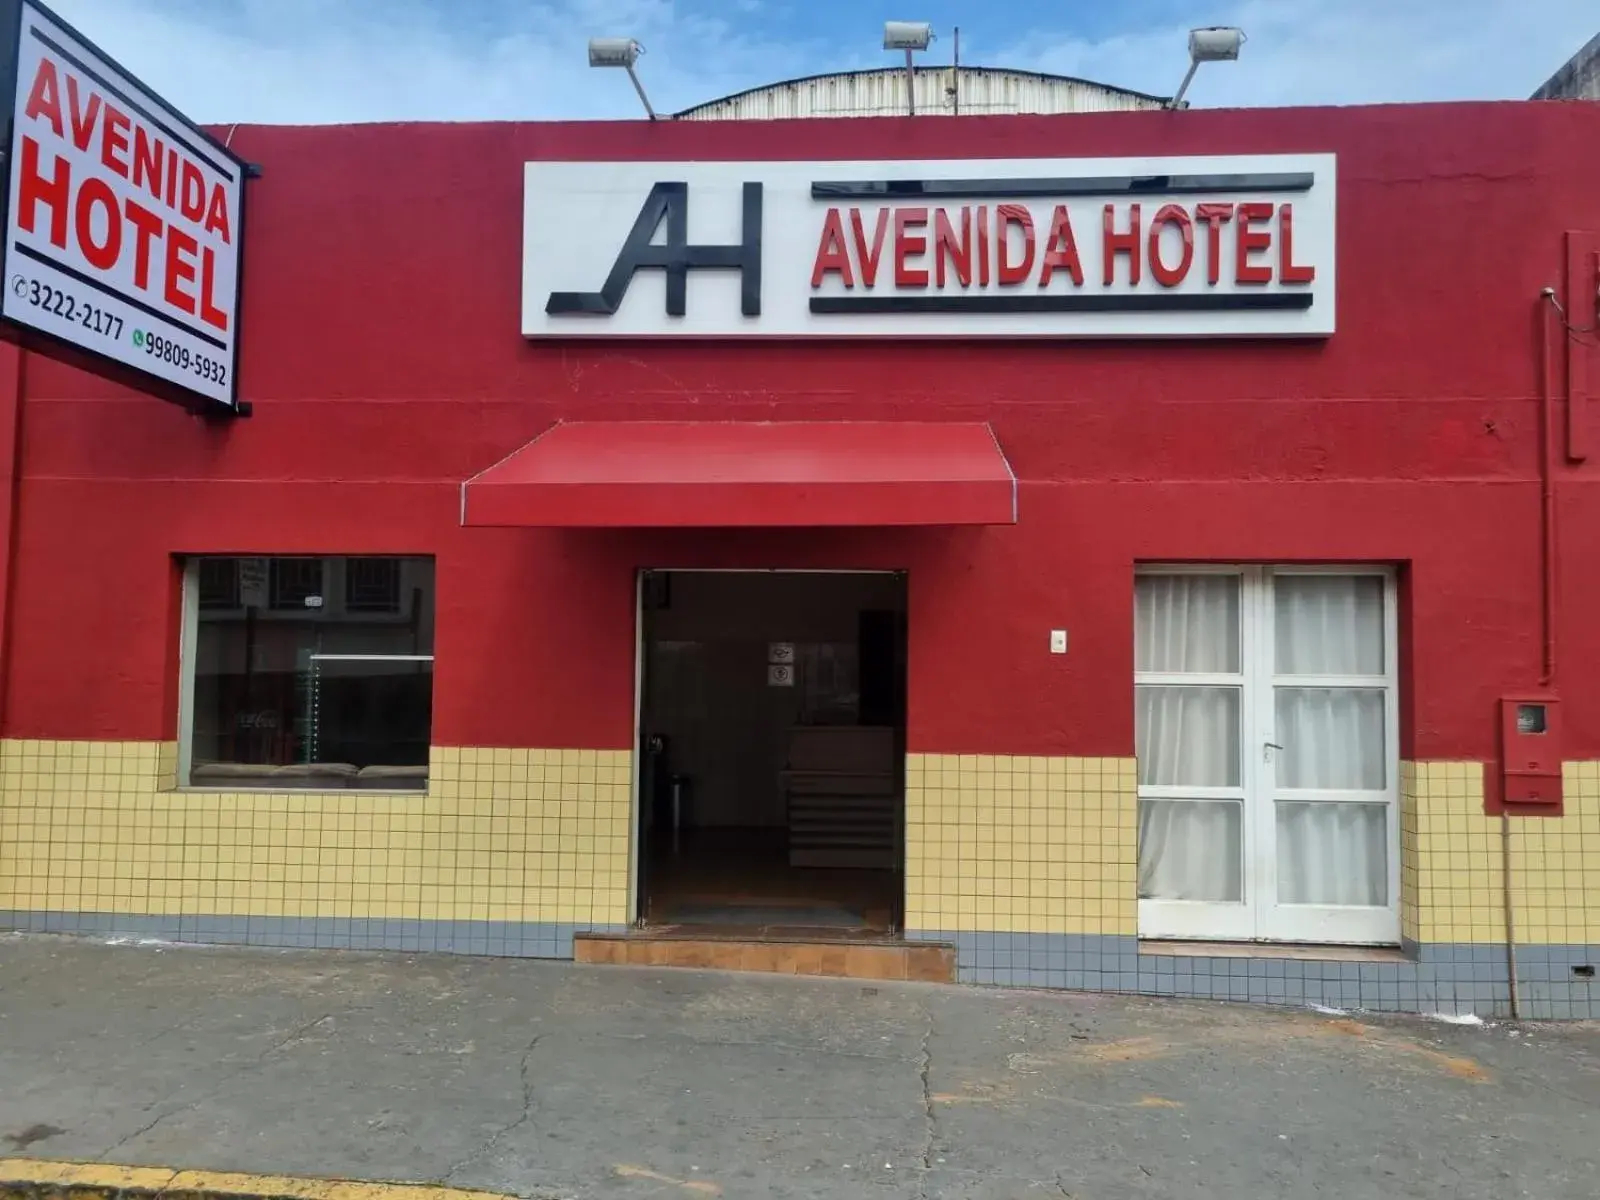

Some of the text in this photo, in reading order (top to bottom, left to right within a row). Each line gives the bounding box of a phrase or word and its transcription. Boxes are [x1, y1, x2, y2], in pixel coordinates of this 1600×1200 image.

[25, 57, 231, 245] AVENIDA
[17, 134, 228, 332] HOTEL
[546, 181, 763, 316] AH
[811, 202, 1315, 288] AVENIDA HOTEL
[29, 279, 227, 386] 3222-2177 99809-5932
